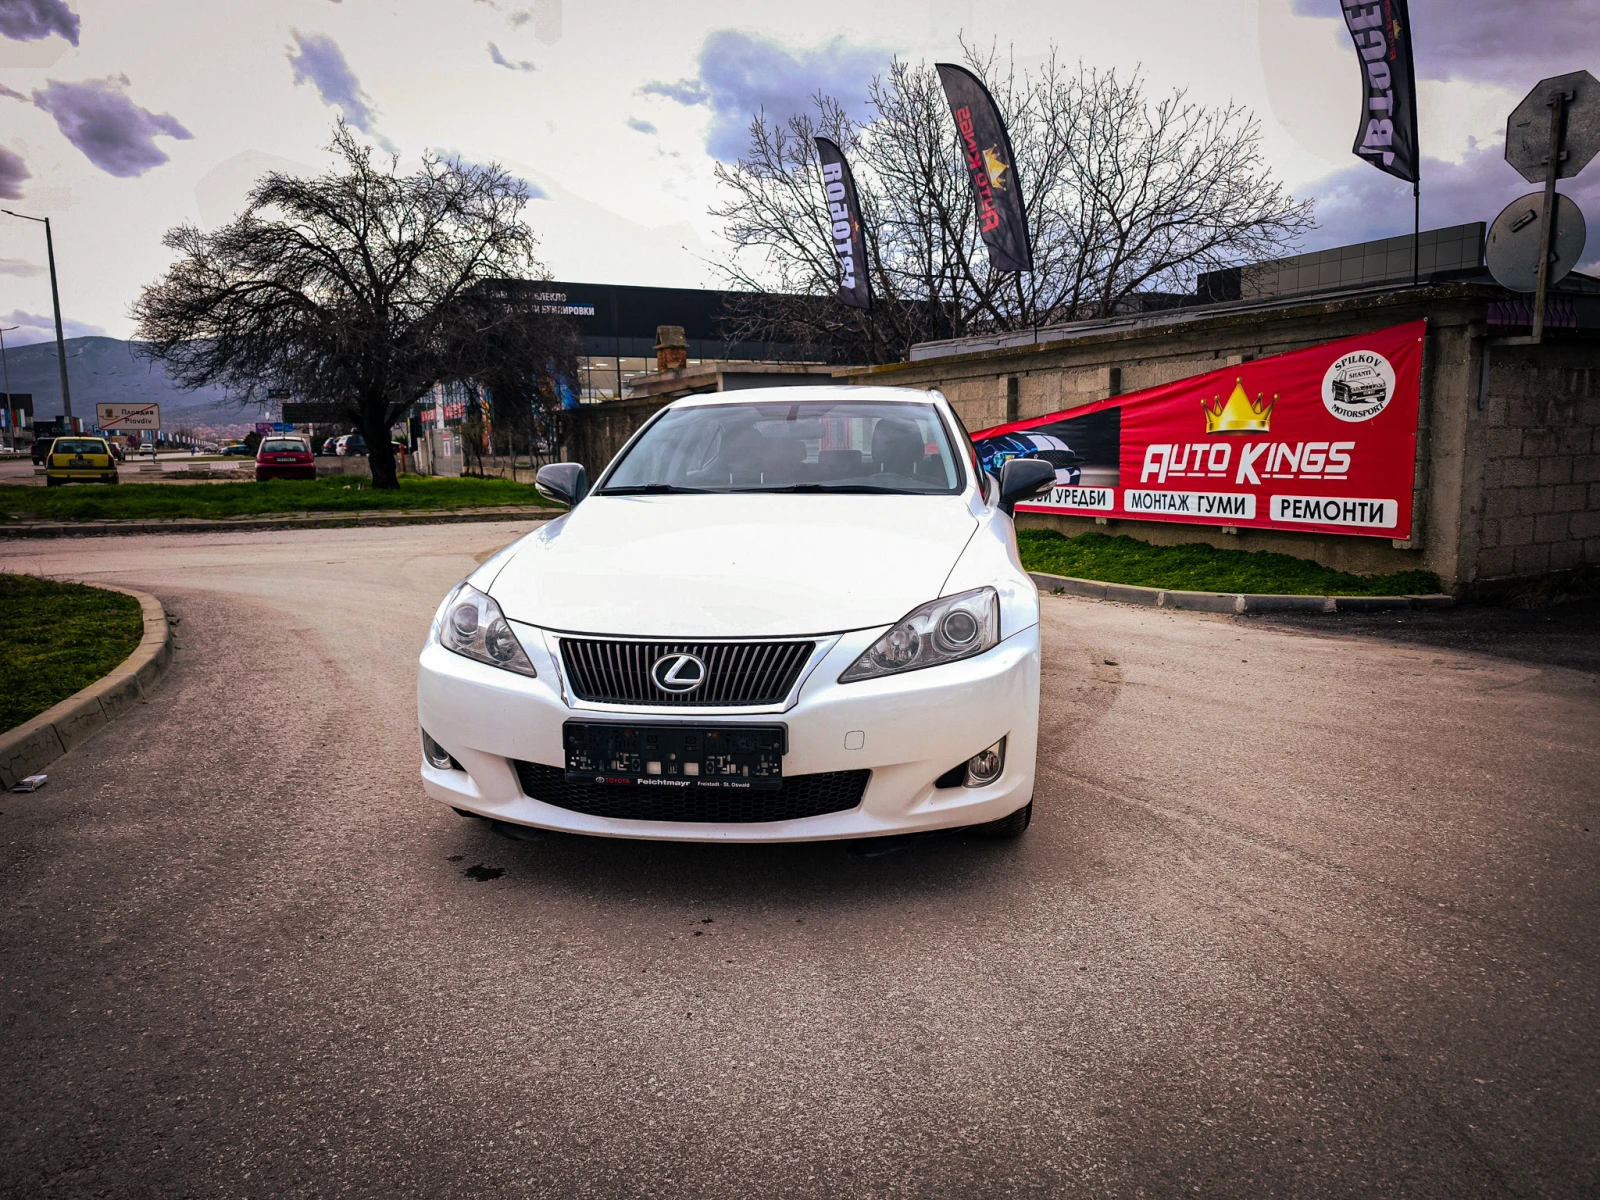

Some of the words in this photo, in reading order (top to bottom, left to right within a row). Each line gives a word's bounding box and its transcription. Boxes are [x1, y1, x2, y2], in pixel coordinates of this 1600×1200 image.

[1335, 354, 1382, 371] SPILKOV
[1348, 370, 1372, 379] SHANTI
[1331, 401, 1385, 418] MOTORSPORT
[125, 417, 152, 425] Plovdiv
[1140, 442, 1232, 484] AUTO
[1236, 440, 1357, 486] KINGS
[1055, 488, 1106, 507] УРЕДБИ
[1130, 491, 1190, 513] МОНТАЖ
[1197, 494, 1247, 517] ГУМИ
[1280, 498, 1385, 524] РЕМОНТИ
[637, 777, 691, 787] Feichtmayr
